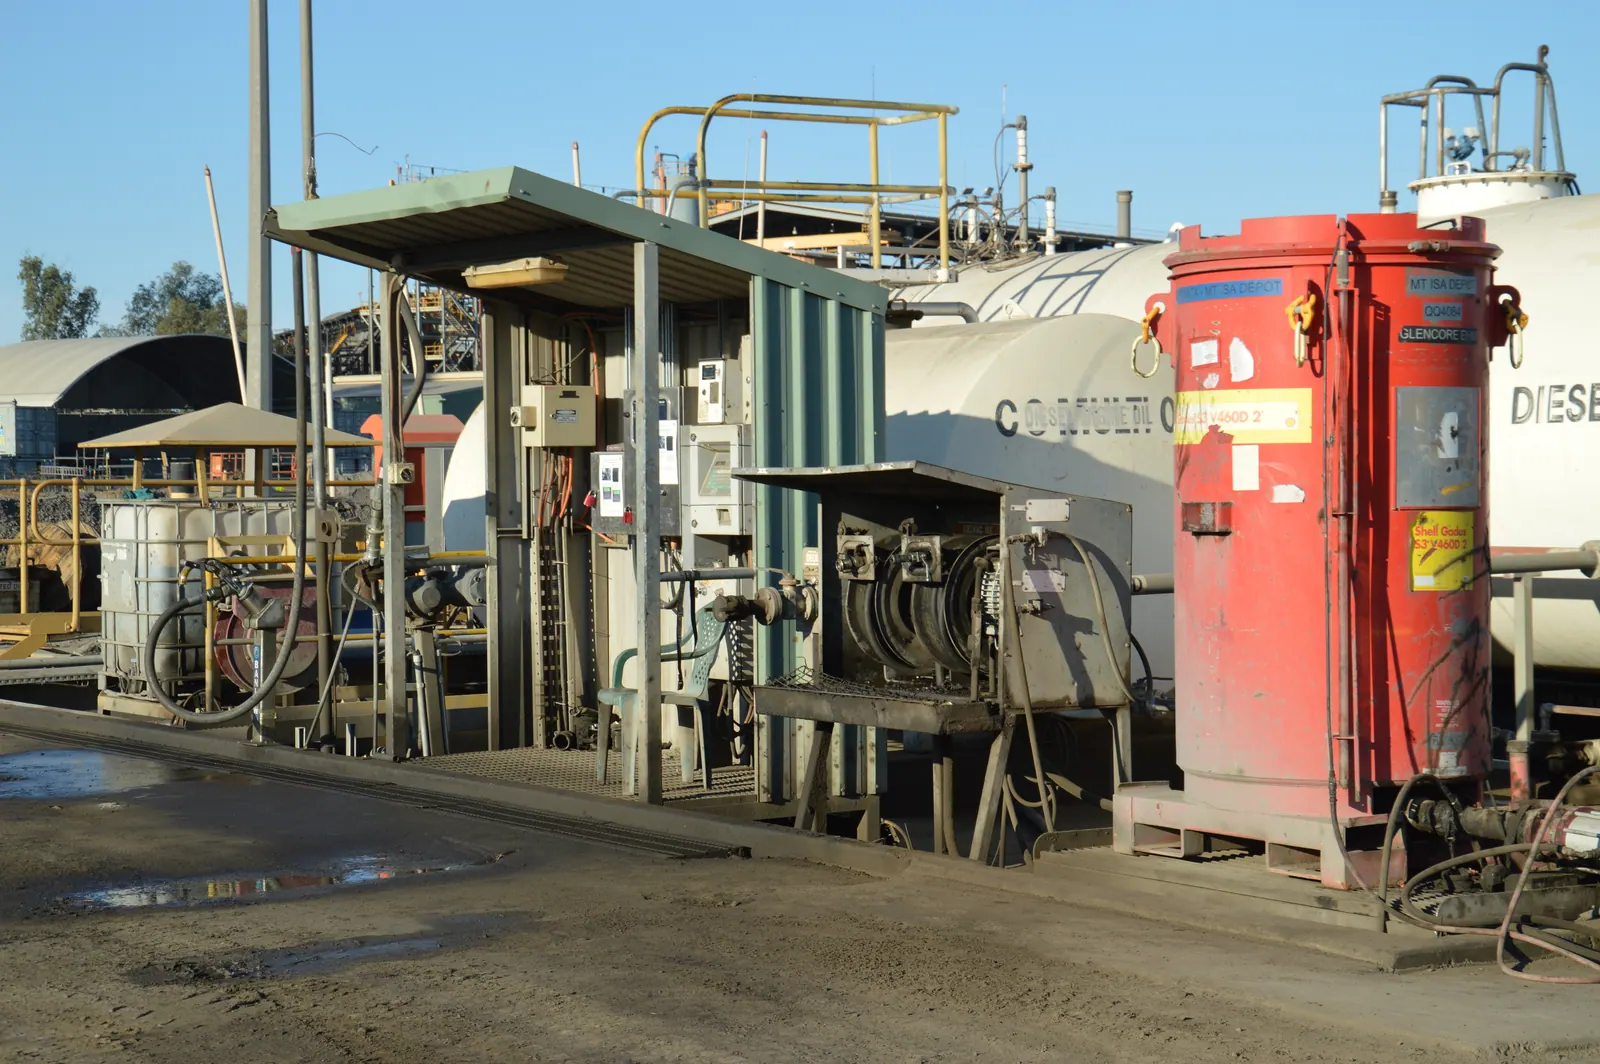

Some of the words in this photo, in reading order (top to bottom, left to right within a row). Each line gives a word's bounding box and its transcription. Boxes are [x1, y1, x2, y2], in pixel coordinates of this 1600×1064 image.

[1220, 283, 1237, 295] SA
[1240, 280, 1281, 294] DEPOT
[1410, 278, 1427, 290] MT
[1430, 278, 1447, 290] ISA
[1400, 328, 1459, 340] GLENCORE
[1209, 409, 1249, 424] V460D
[1415, 525, 1439, 537] Shell
[1441, 525, 1467, 537] Gadus
[1414, 538, 1428, 550] S3
[1430, 538, 1460, 550] V460D
